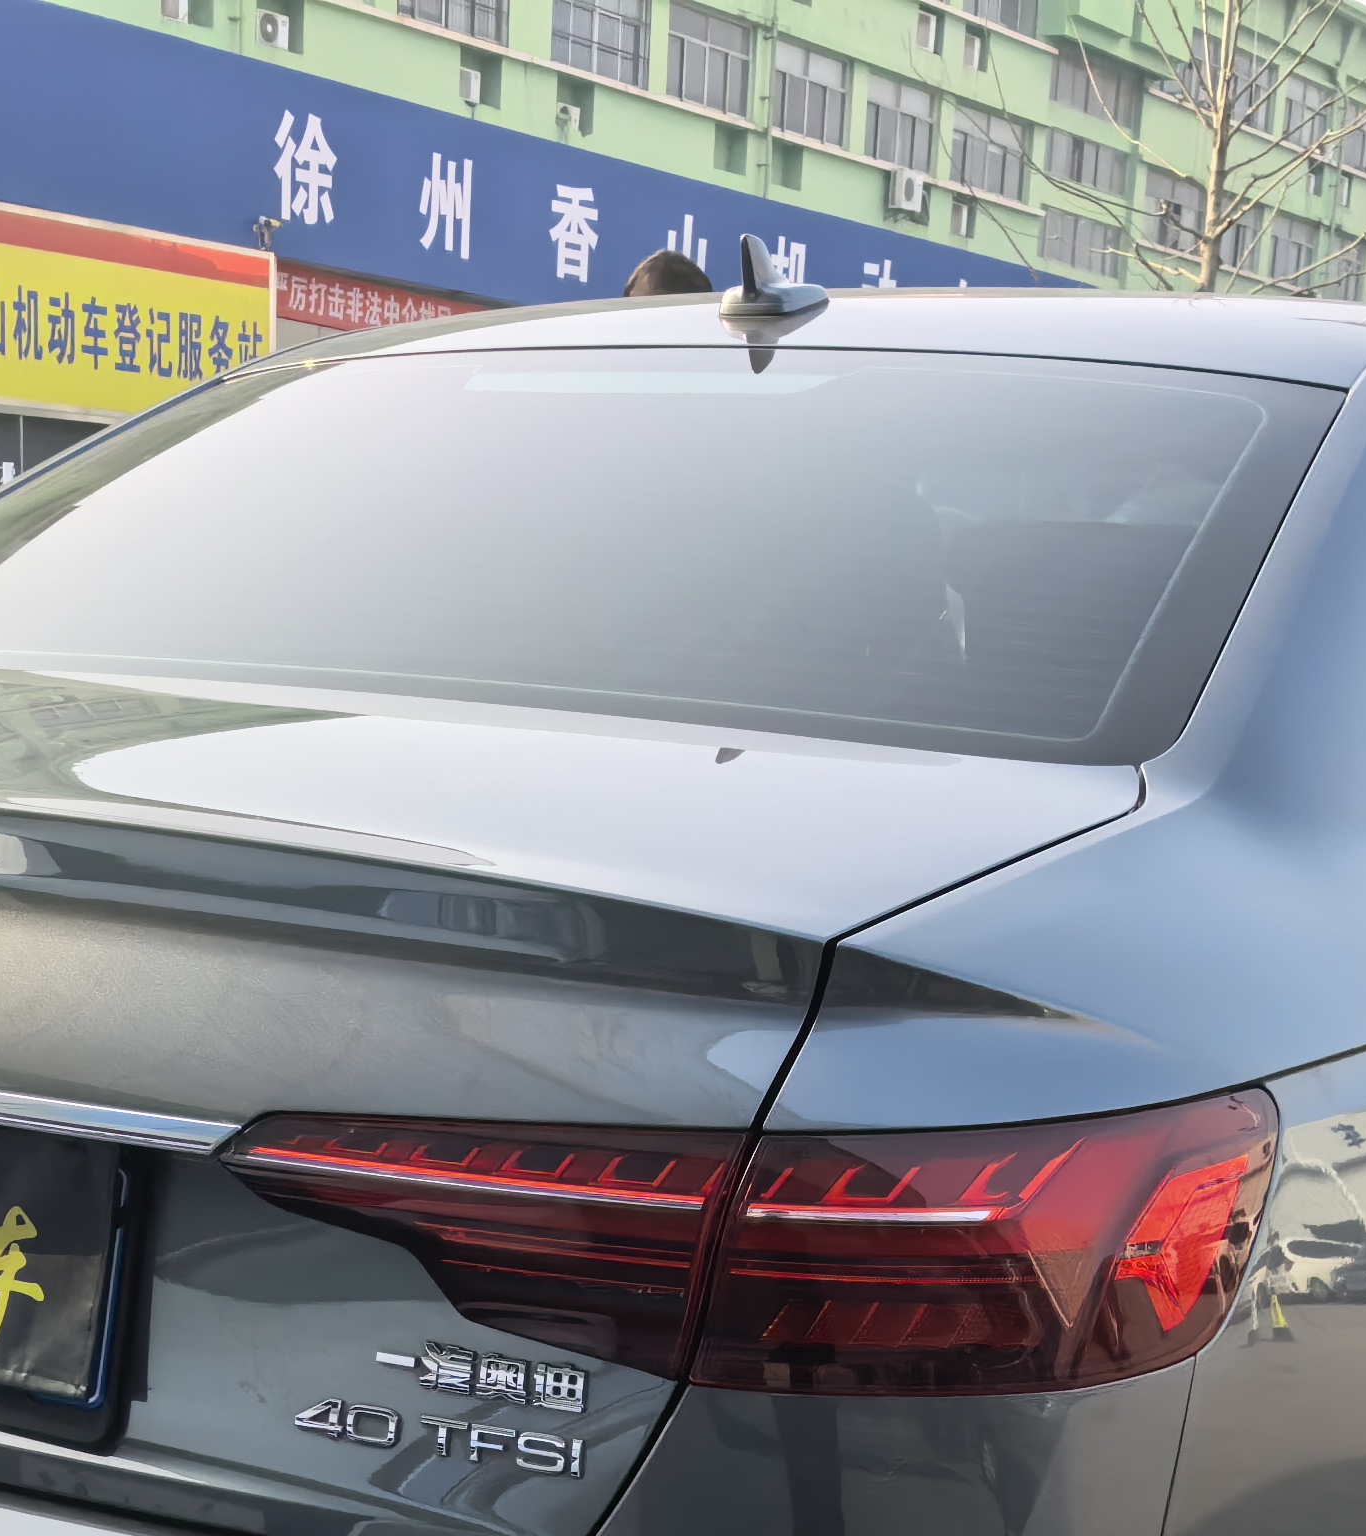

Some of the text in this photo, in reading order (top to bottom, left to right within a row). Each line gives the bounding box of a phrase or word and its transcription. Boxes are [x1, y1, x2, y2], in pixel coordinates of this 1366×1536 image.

[274, 109, 968, 288] 徐州香山
[375, 1339, 587, 1414] 一汽奥迪
[293, 1397, 586, 1479] 40 TFSI
